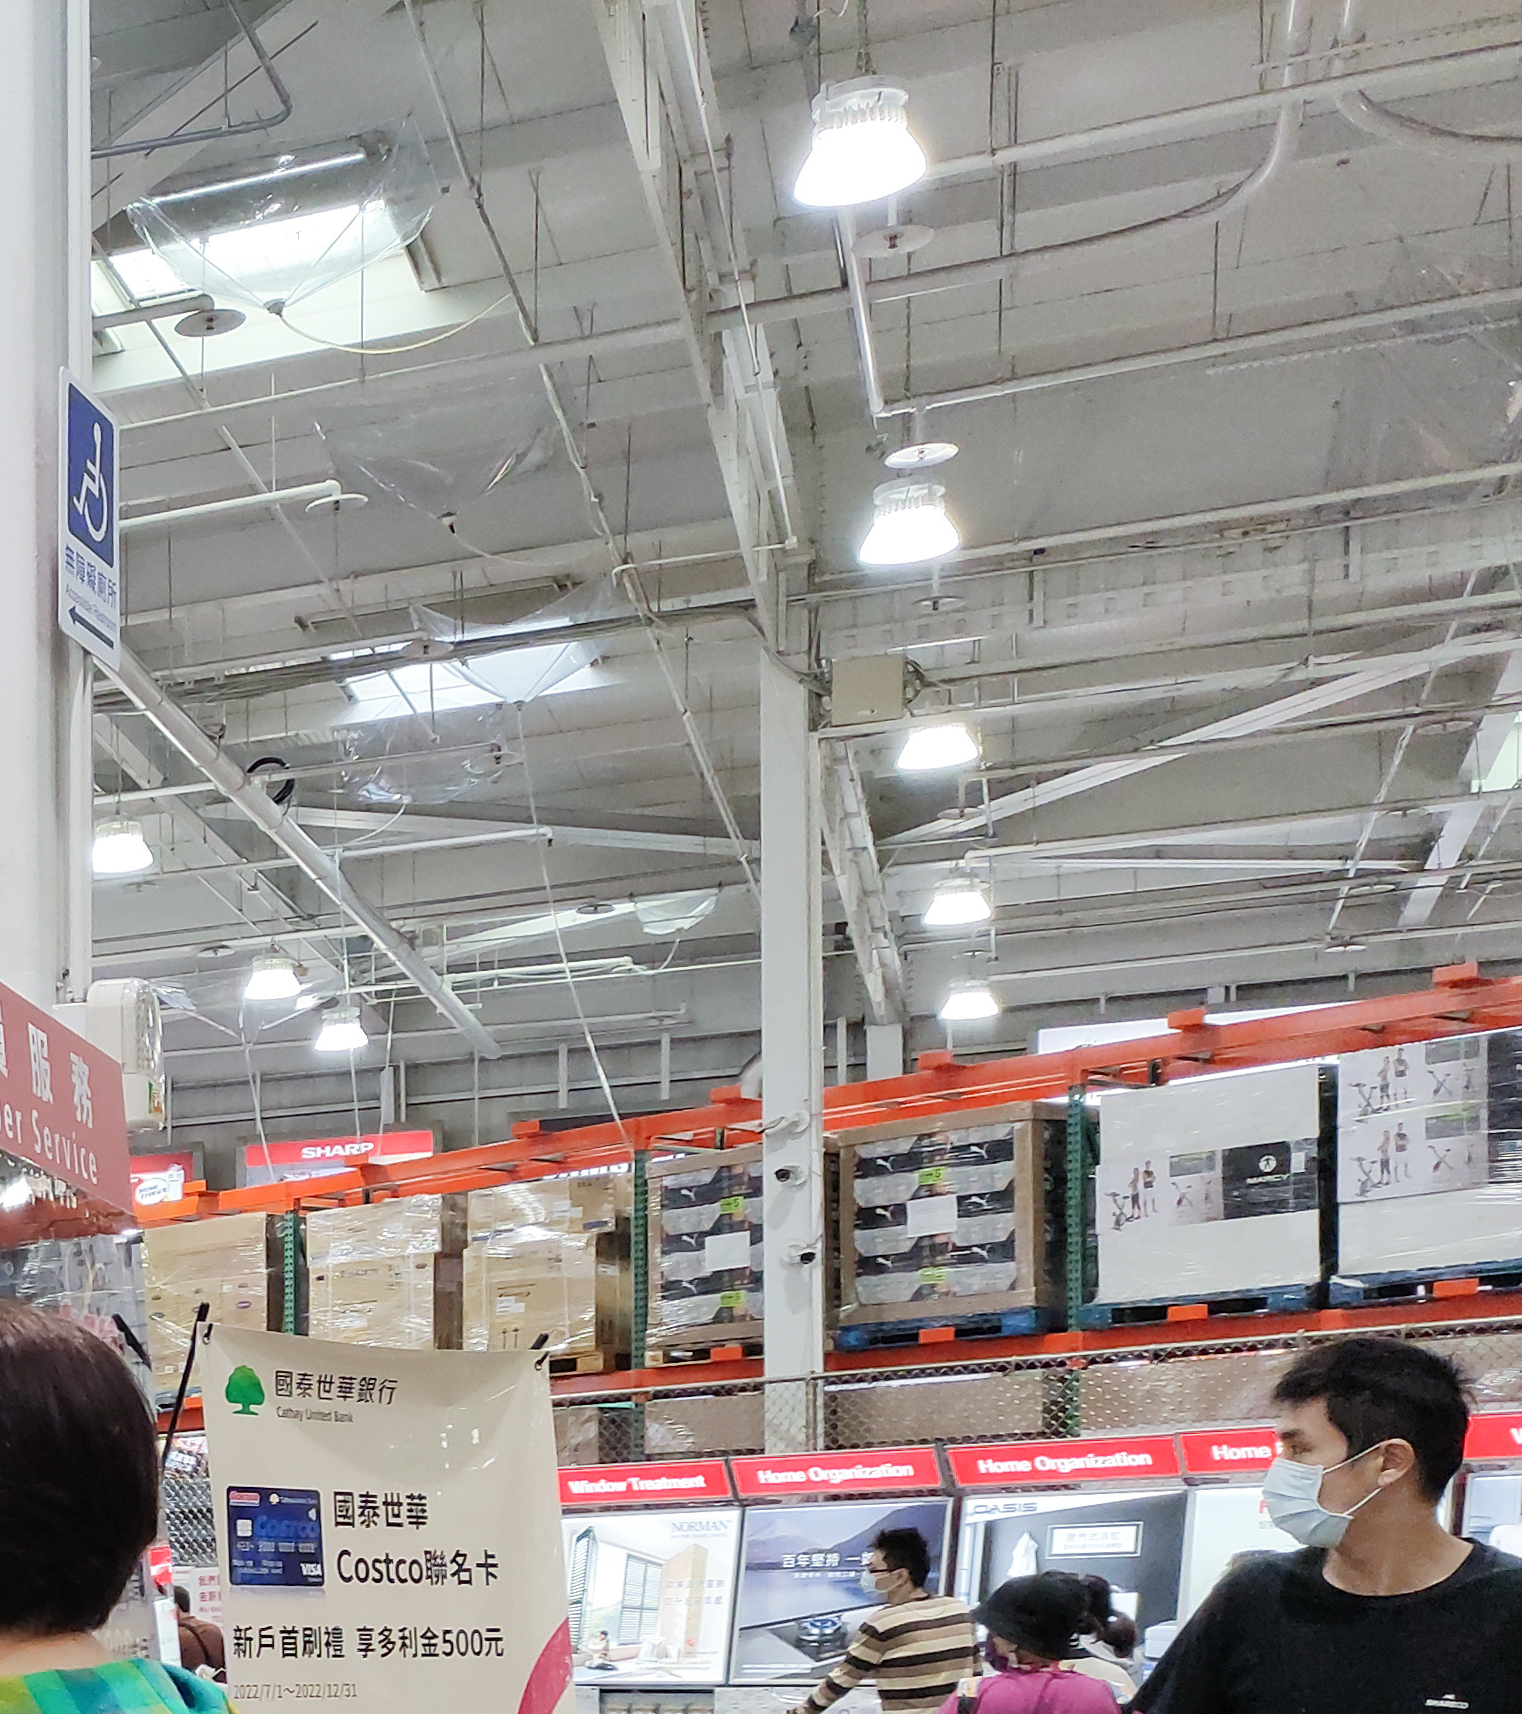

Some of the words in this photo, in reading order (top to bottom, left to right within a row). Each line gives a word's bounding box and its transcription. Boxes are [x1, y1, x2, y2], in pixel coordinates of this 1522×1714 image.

[31, 1108, 99, 1186] Service
[300, 1141, 375, 1160] SHARP
[274, 1369, 398, 1406] 國泰世華銀行
[275, 1405, 304, 1423] Cathay
[305, 1407, 333, 1422] United
[333, 1410, 354, 1424] Bank
[978, 1458, 1032, 1475] Home
[1034, 1450, 1153, 1475] Organization
[1211, 1443, 1272, 1462] Home
[567, 1478, 627, 1495] Window
[629, 1473, 706, 1492] Treatment
[756, 1467, 806, 1486] Home
[808, 1461, 914, 1484] Organization
[333, 1490, 429, 1530] 國泰世華
[671, 1520, 729, 1533] NORMAN
[300, 1563, 323, 1576] VISA
[336, 1549, 500, 1587] Costco聯名卡
[232, 1625, 346, 1660] 新戶首刷禮
[355, 1625, 506, 1660] 享多利金500元
